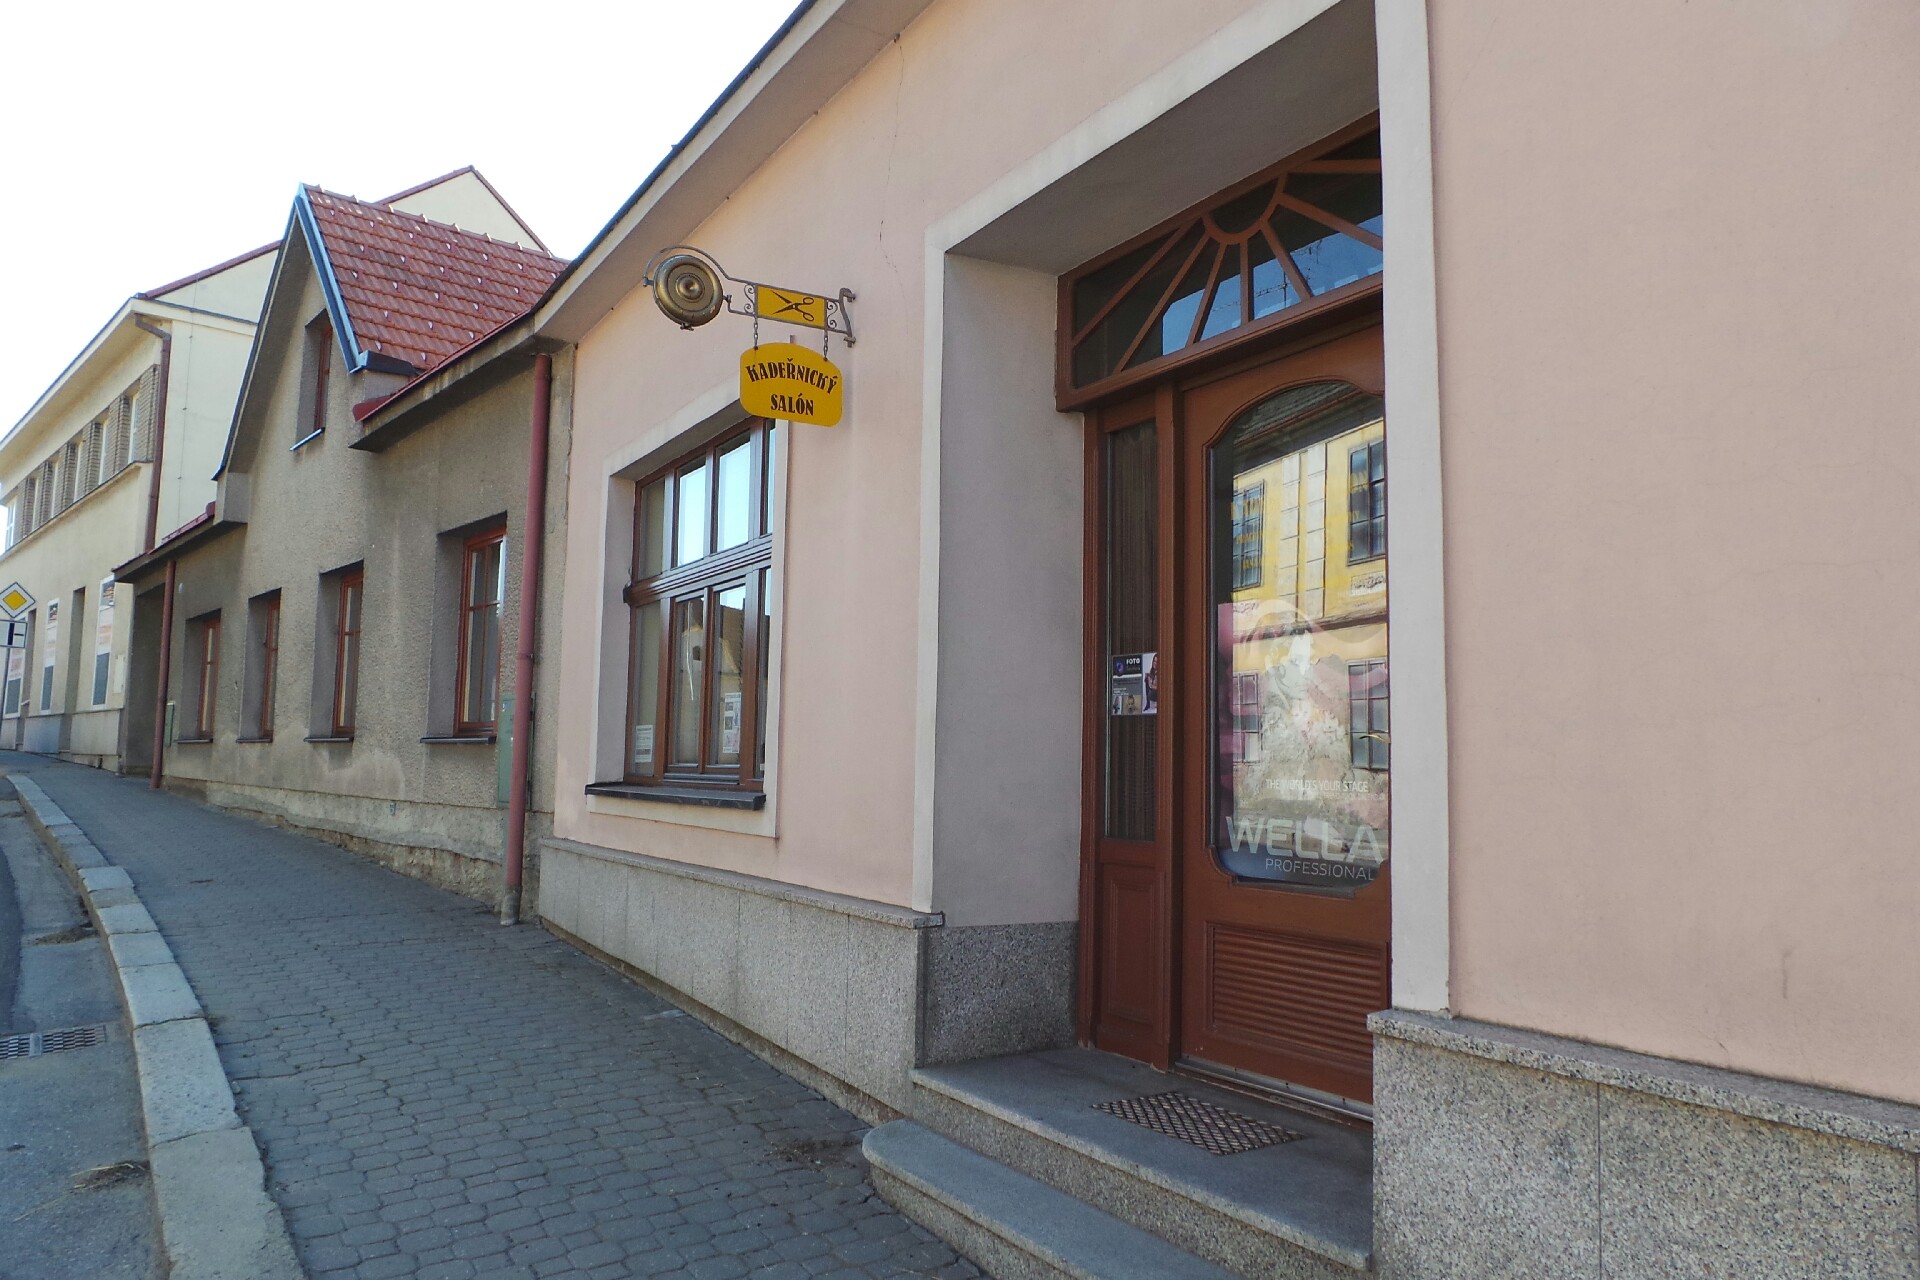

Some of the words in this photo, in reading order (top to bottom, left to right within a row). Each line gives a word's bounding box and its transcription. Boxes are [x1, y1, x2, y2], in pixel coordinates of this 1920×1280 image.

[746, 358, 838, 394] KADEŘNICKÝ
[771, 393, 814, 416] SALÓN
[1266, 779, 1280, 790] THE
[1318, 780, 1341, 792] YOUR
[1343, 780, 1369, 792] STAGE
[1225, 815, 1384, 864] WELLA
[1265, 858, 1375, 881] PROFESSIONAL
